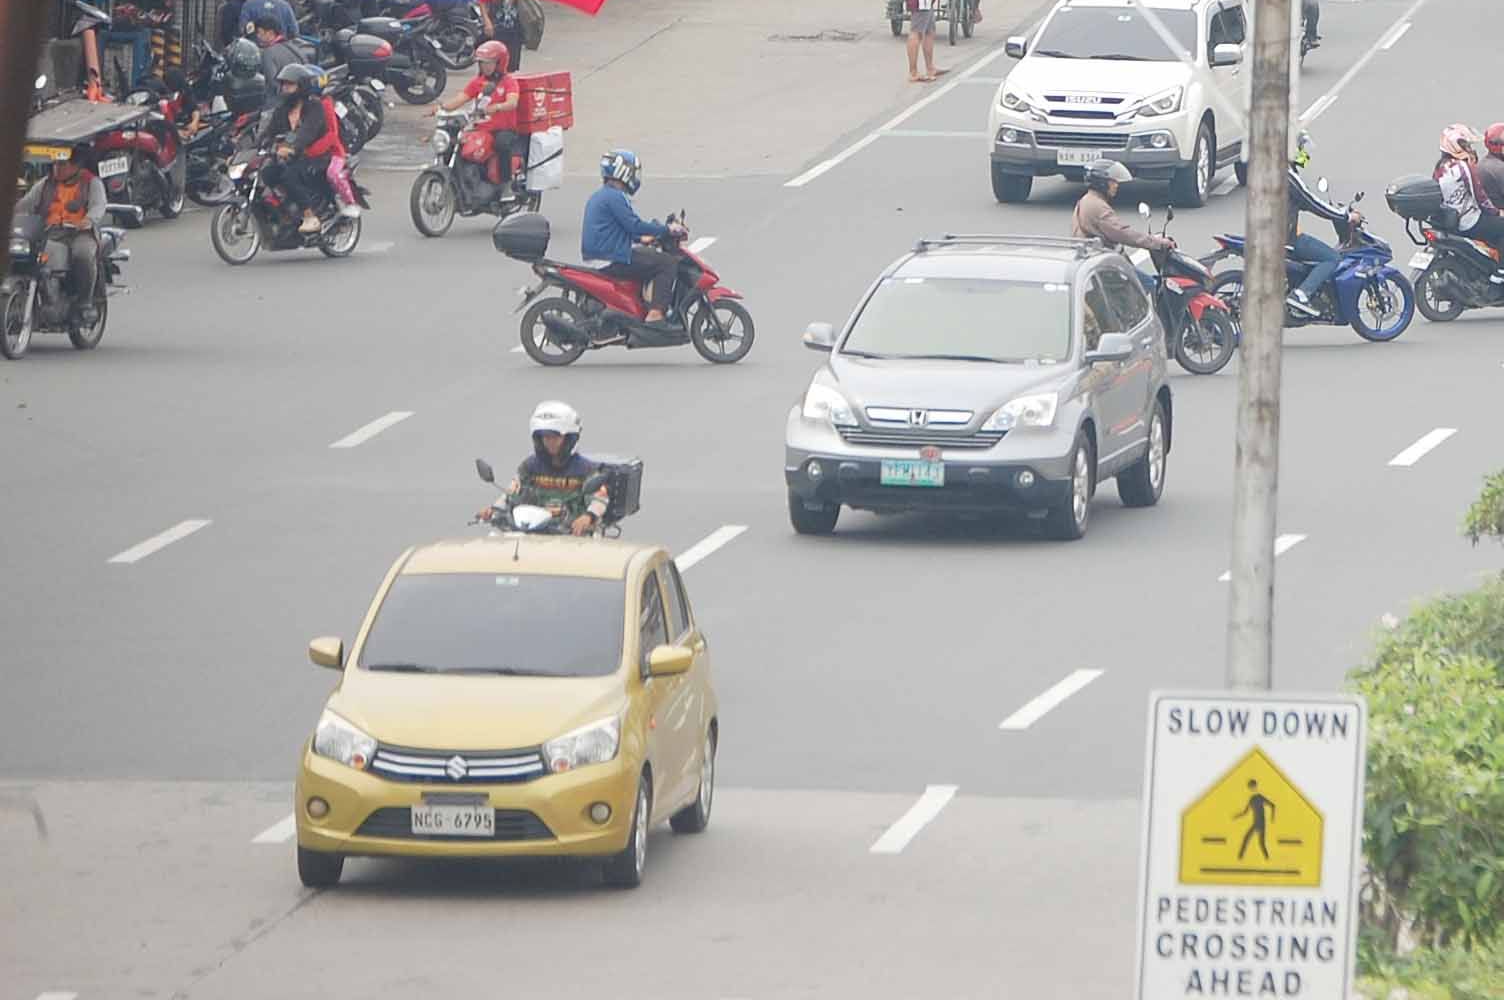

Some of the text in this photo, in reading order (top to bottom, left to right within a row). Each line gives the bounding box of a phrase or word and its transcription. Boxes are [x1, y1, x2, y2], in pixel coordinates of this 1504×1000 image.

[1168, 708, 1348, 737] SLOW DOWN
[454, 813, 493, 830] 6795
[1158, 897, 1337, 925] PEDESTRIAN
[1156, 933, 1335, 962] CROSSING
[1185, 969, 1302, 996] AHEAD
